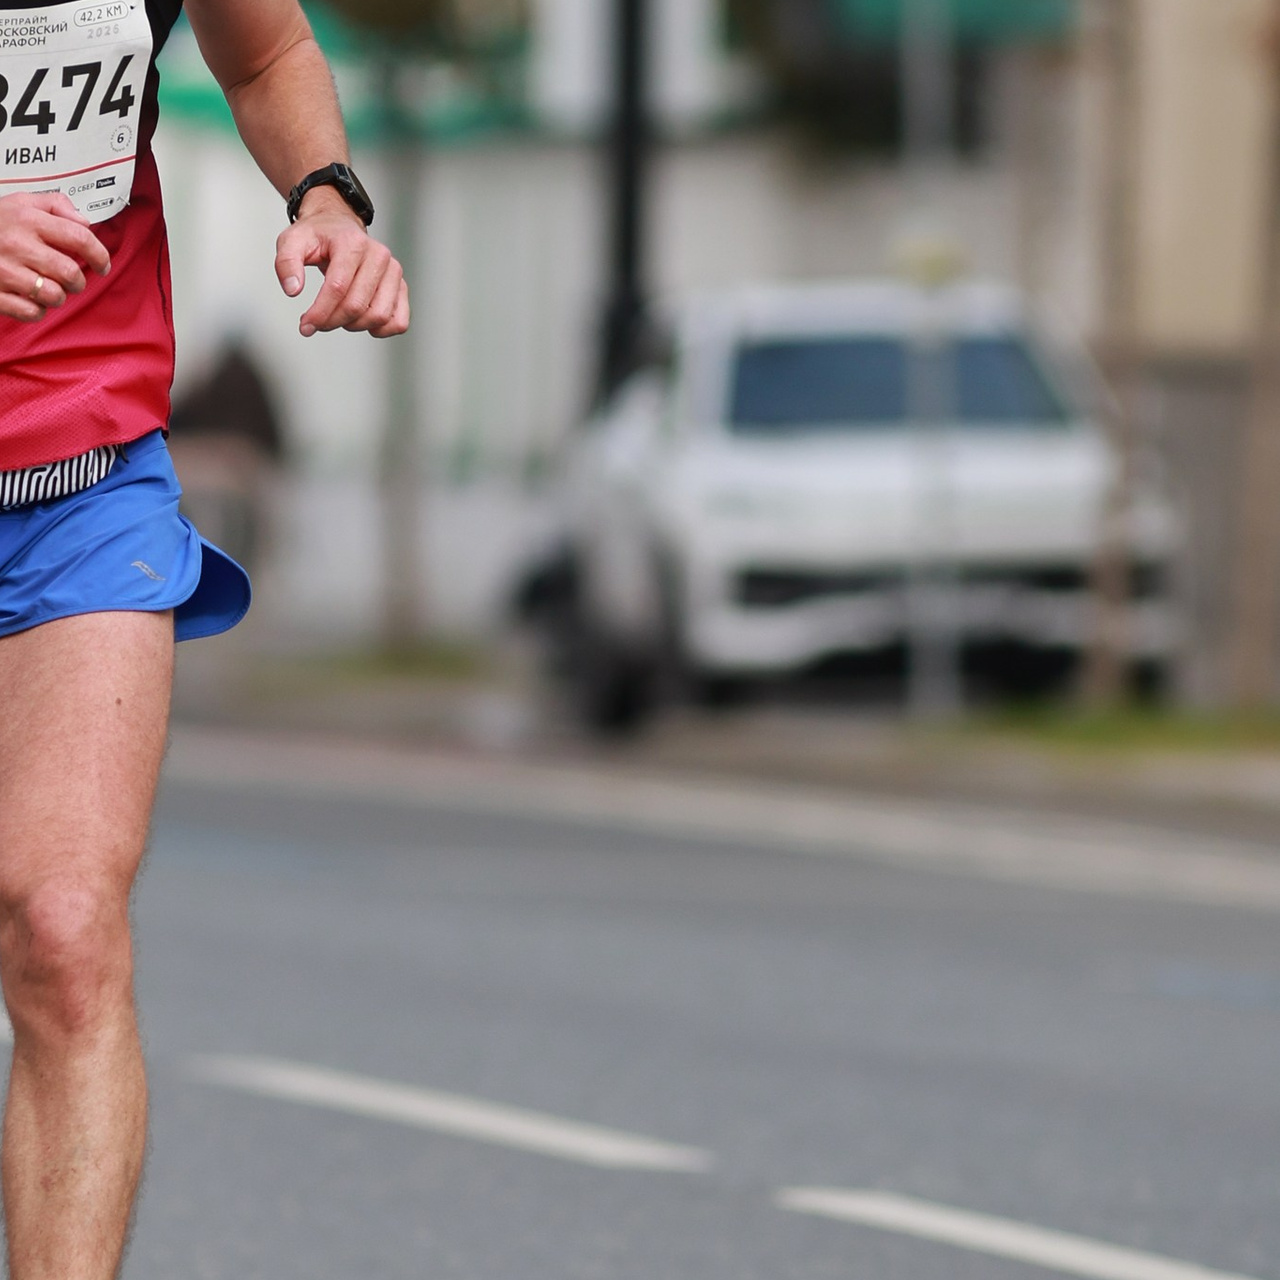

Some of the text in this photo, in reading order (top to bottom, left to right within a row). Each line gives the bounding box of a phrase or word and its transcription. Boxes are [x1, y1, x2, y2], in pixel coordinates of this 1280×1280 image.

[80, 8, 103, 22] 42,2
[117, 132, 124, 144] 6
[5, 145, 56, 165] ИВАН
[77, 182, 95, 193] СБЕР
